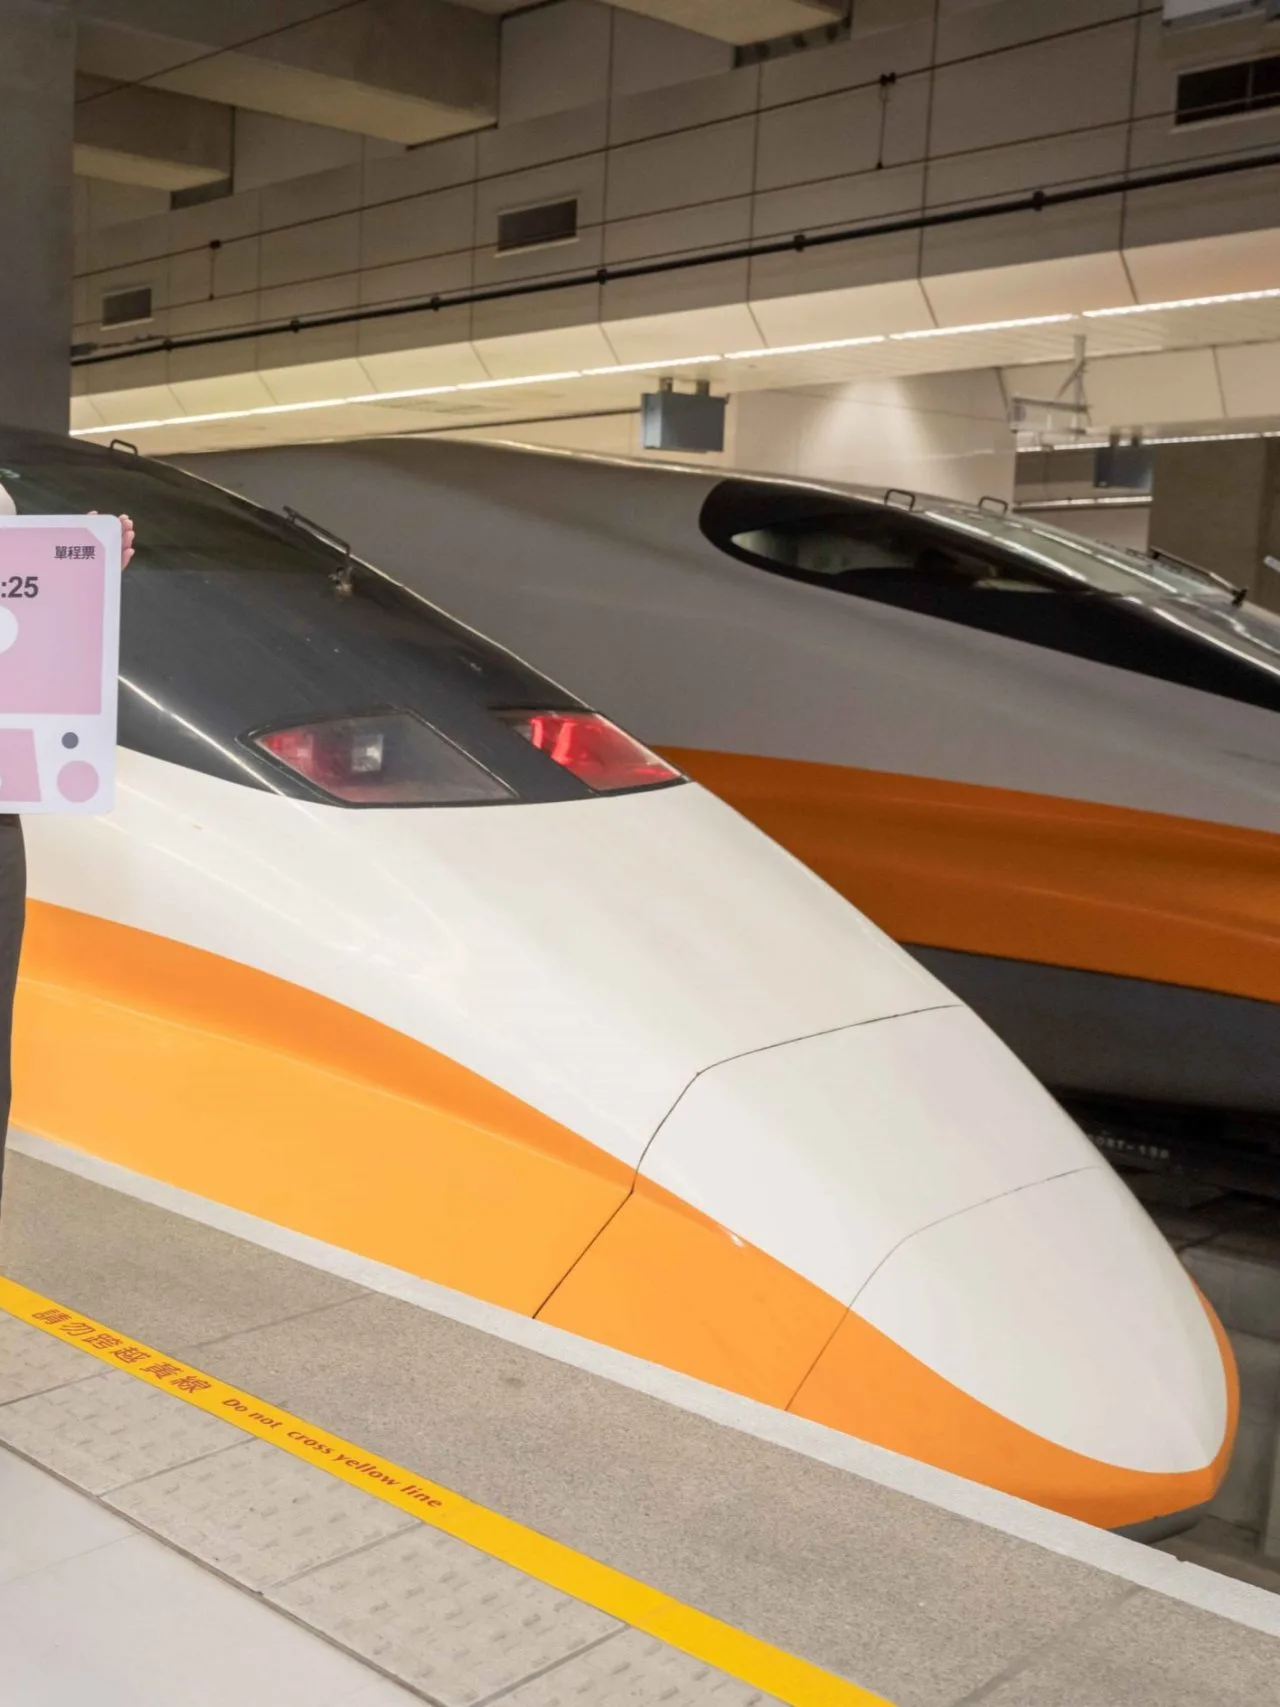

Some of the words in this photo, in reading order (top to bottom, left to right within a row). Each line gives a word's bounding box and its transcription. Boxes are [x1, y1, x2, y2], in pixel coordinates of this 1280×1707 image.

[31, 1308, 212, 1394] 請勿跨越黃線
[222, 1397, 248, 1413] Do
[247, 1412, 283, 1430] not
[286, 1430, 334, 1455] cross
[332, 1453, 401, 1487] yellow
[400, 1485, 443, 1508] line
